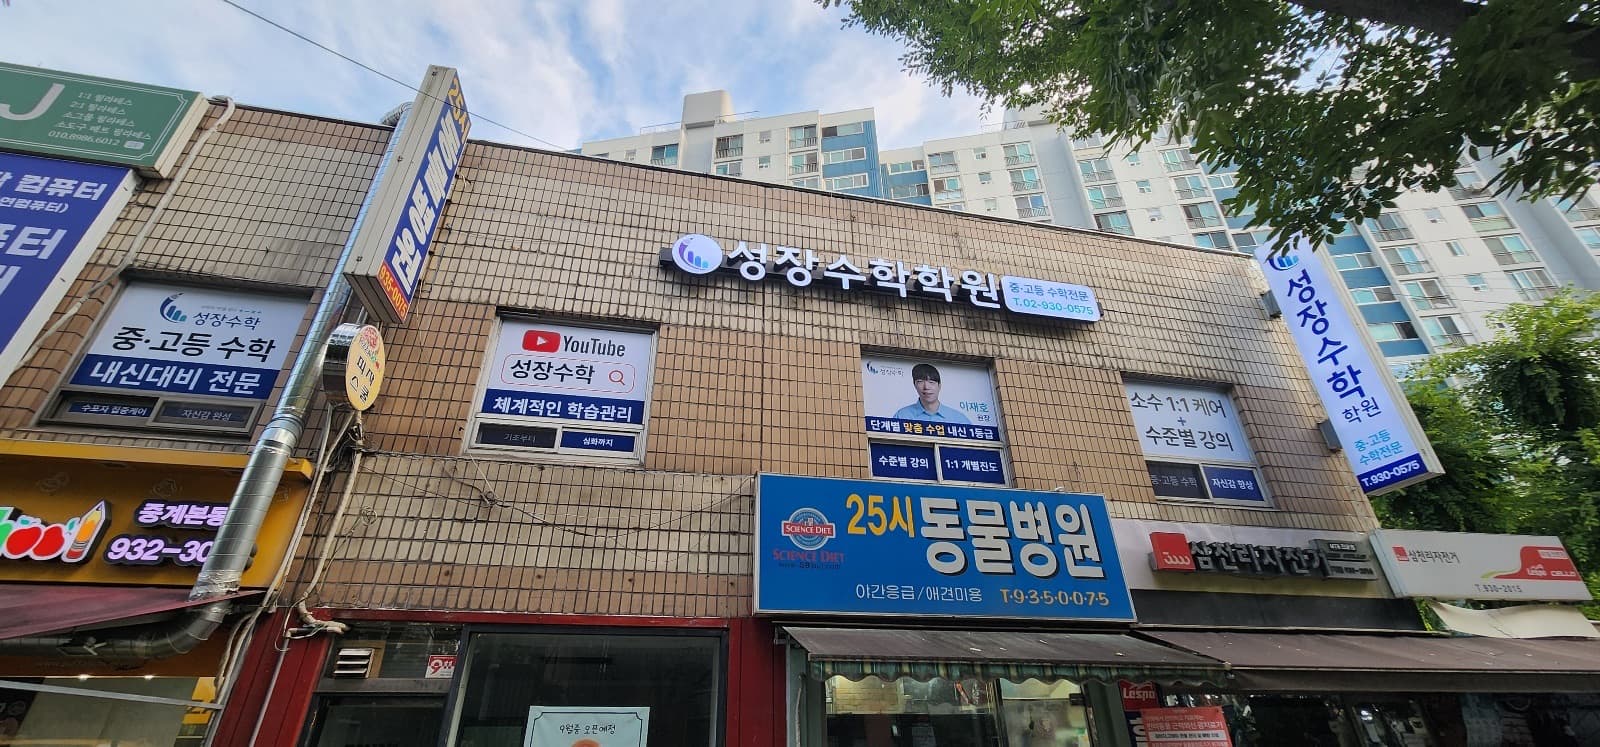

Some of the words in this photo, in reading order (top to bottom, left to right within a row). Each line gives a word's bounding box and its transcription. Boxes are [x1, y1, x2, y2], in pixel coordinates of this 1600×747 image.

[14, 174, 108, 201] 컴퓨터
[728, 240, 1001, 309] 성장수학학원
[379, 264, 407, 319] 935-0075
[1009, 282, 1044, 296] 중·고등
[1047, 287, 1089, 301] 수학전문
[1012, 297, 1094, 315] T.02-930-0575
[192, 311, 262, 330] 성장수학
[112, 326, 212, 357] 중·고등
[217, 336, 276, 363] 수학
[563, 335, 626, 357] YouTube
[90, 361, 203, 391] 내신대비
[208, 370, 261, 395] 전문
[510, 359, 596, 384] 성장수학
[81, 404, 109, 414] 수포자
[493, 396, 562, 417] 체계적인
[567, 402, 632, 423] 학습관리
[1130, 392, 1163, 412] 소수
[1166, 396, 1189, 413] 1:1
[1192, 398, 1226, 418] 케어
[1342, 397, 1381, 424] 학원
[870, 419, 901, 432] 단계별
[903, 423, 923, 433] 맞춤
[926, 425, 945, 436] 수업
[948, 427, 967, 438] 내신
[969, 428, 993, 439] 1등급
[1145, 425, 1197, 449] 수준별
[1198, 430, 1234, 452] 강의
[1354, 429, 1391, 451] 중·고등
[583, 437, 613, 447] 심화까지
[879, 455, 908, 468] 수준별
[910, 457, 928, 469] 강의
[1359, 441, 1403, 466] 수학전문
[945, 459, 958, 470] 1:1
[962, 460, 998, 472] 개별진도
[1361, 460, 1420, 488] T.930-0575
[1180, 477, 1198, 488] 수학
[1212, 478, 1237, 489] 자신감
[138, 502, 230, 527] 중계본동
[785, 524, 815, 534] SCIENCE
[815, 526, 833, 535] DIET
[846, 493, 915, 538] 25시
[920, 495, 1108, 579] 동물병원
[773, 548, 817, 562] SCIENCE
[820, 550, 845, 563] DIET
[584, 724, 616, 735] 오픈예정
